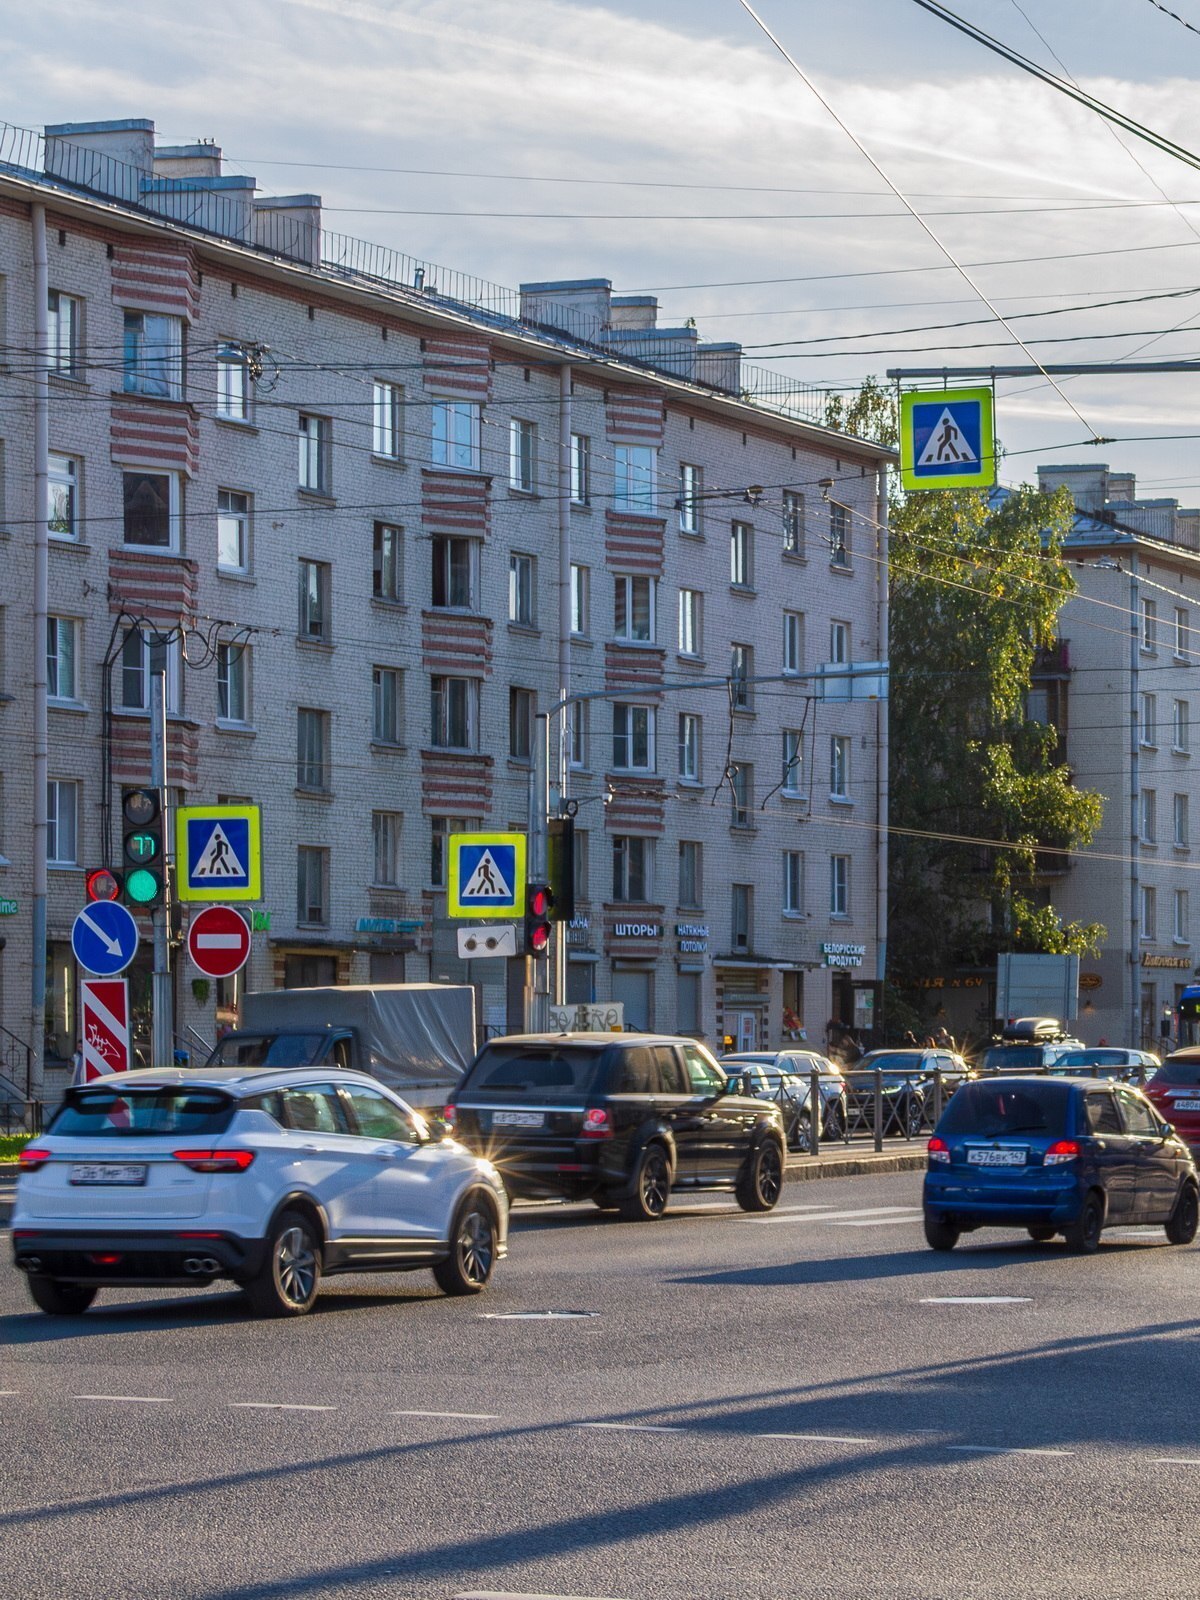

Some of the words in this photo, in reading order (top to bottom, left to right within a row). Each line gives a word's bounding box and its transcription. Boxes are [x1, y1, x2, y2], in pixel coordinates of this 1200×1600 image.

[615, 923, 657, 936] ШТОРЫ
[677, 924, 710, 937] НАТЯЖНЫЕ
[680, 940, 708, 952] ПОТОЛКИ
[823, 943, 867, 955] БЕЛОРУССКИЕ
[828, 955, 863, 967] ПРОДУКТЫ
